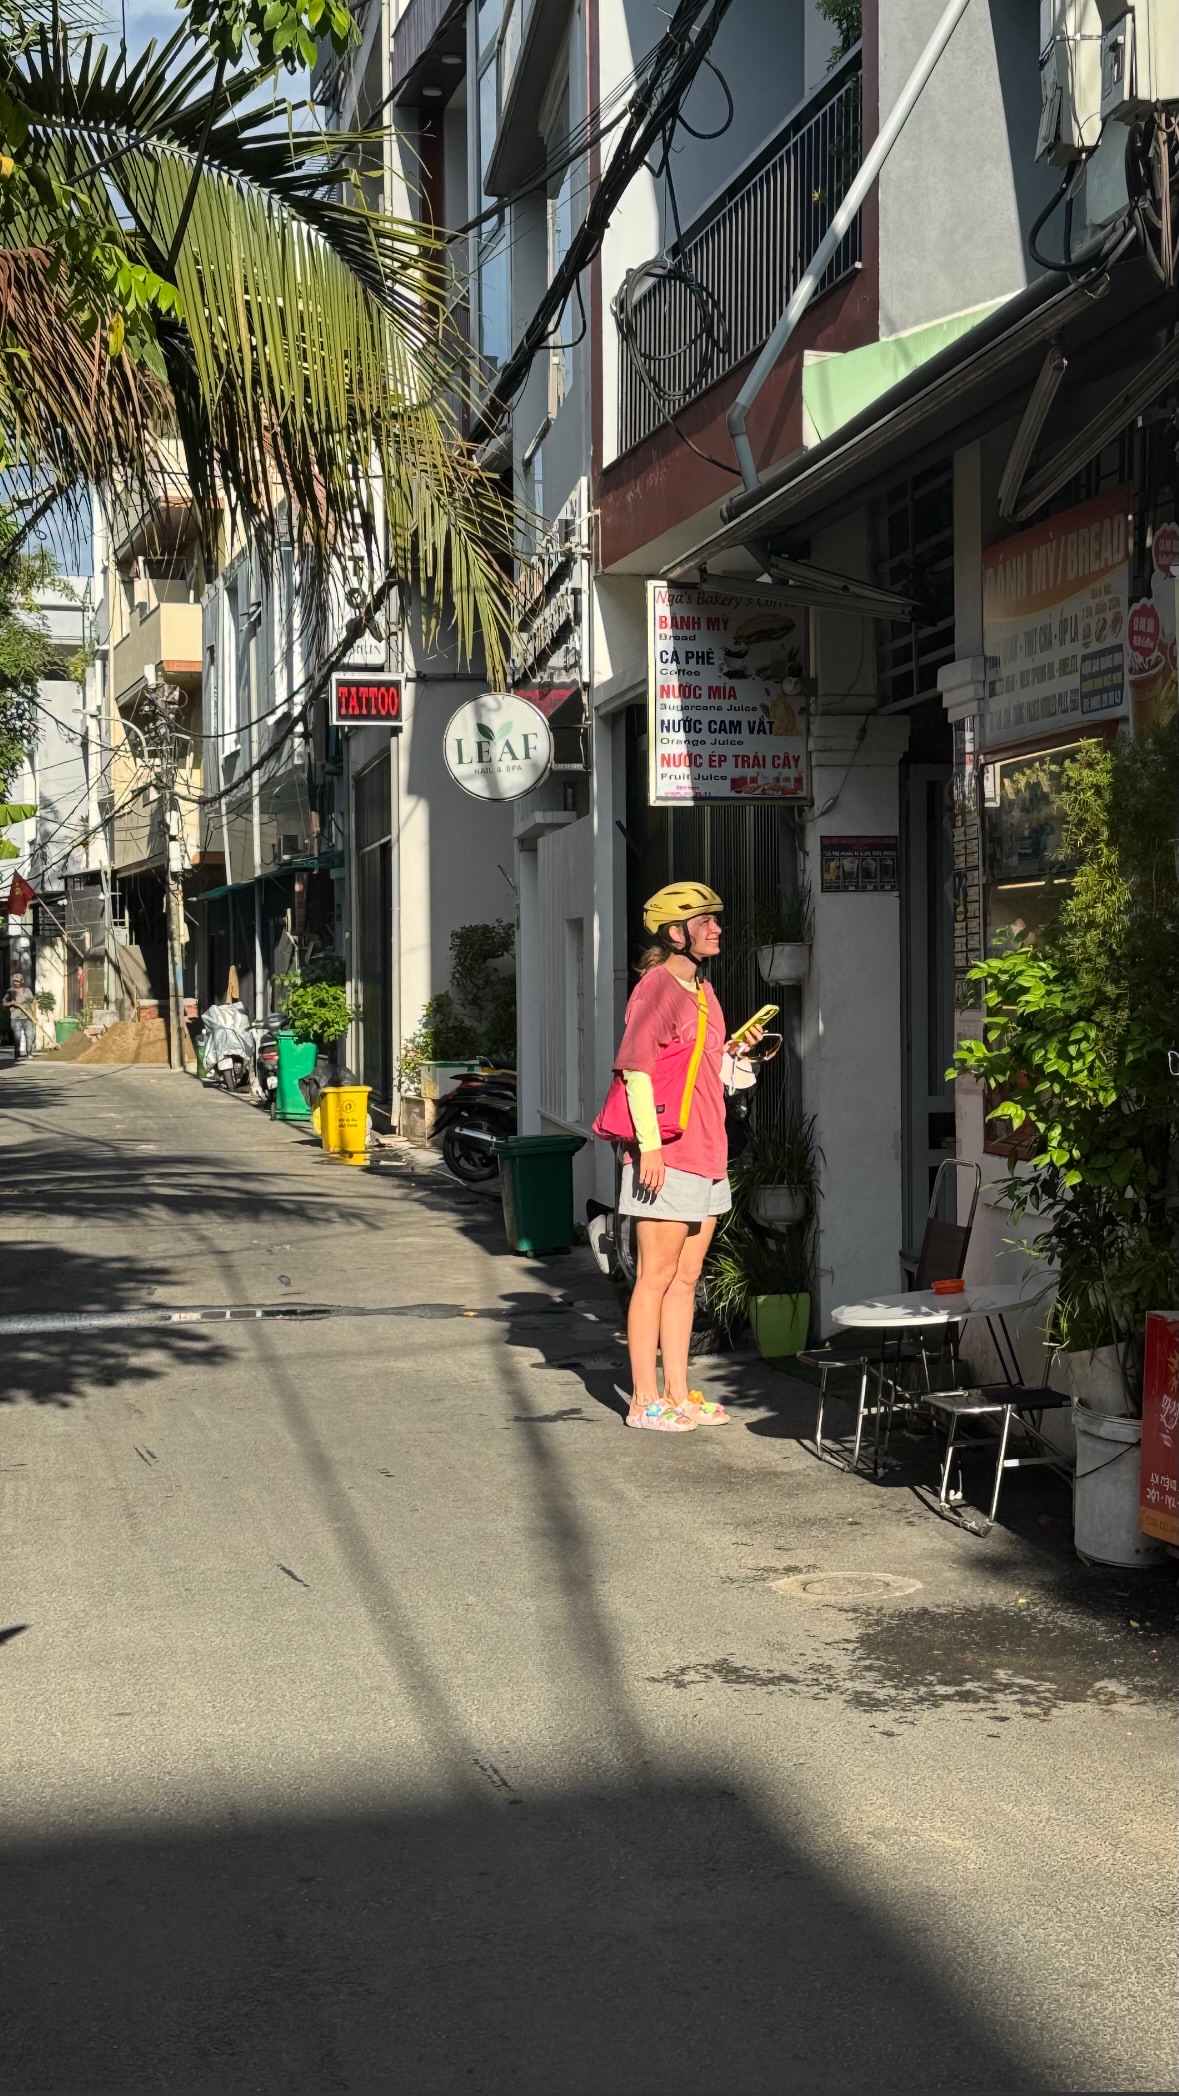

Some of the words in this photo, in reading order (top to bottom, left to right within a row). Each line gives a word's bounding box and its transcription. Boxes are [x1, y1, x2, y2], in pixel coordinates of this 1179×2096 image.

[656, 590, 693, 607] Nga's
[696, 590, 742, 610] Bakery
[659, 612, 702, 631] BÁNH
[659, 633, 697, 642] Bread
[660, 646, 681, 665] CÀ
[685, 647, 716, 666] PHÊ
[660, 668, 701, 677] Coffee
[338, 687, 399, 715] TATTOO
[708, 682, 738, 701] MÍA
[660, 703, 723, 713] Sugarcane
[726, 703, 758, 712] Juice
[660, 716, 703, 735] NƯỚC
[708, 719, 743, 735] CAM
[455, 732, 539, 765] LEAF
[660, 737, 707, 747] Orange
[711, 738, 744, 747] Juice
[660, 750, 703, 769] NƯỚC
[708, 750, 728, 769] ÉP
[732, 751, 766, 770] TRÁI
[771, 752, 801, 770] CÂY
[474, 766, 494, 775] NAIL
[506, 765, 524, 773] SPA
[660, 773, 691, 782] Fruit
[693, 773, 728, 782] Juice
